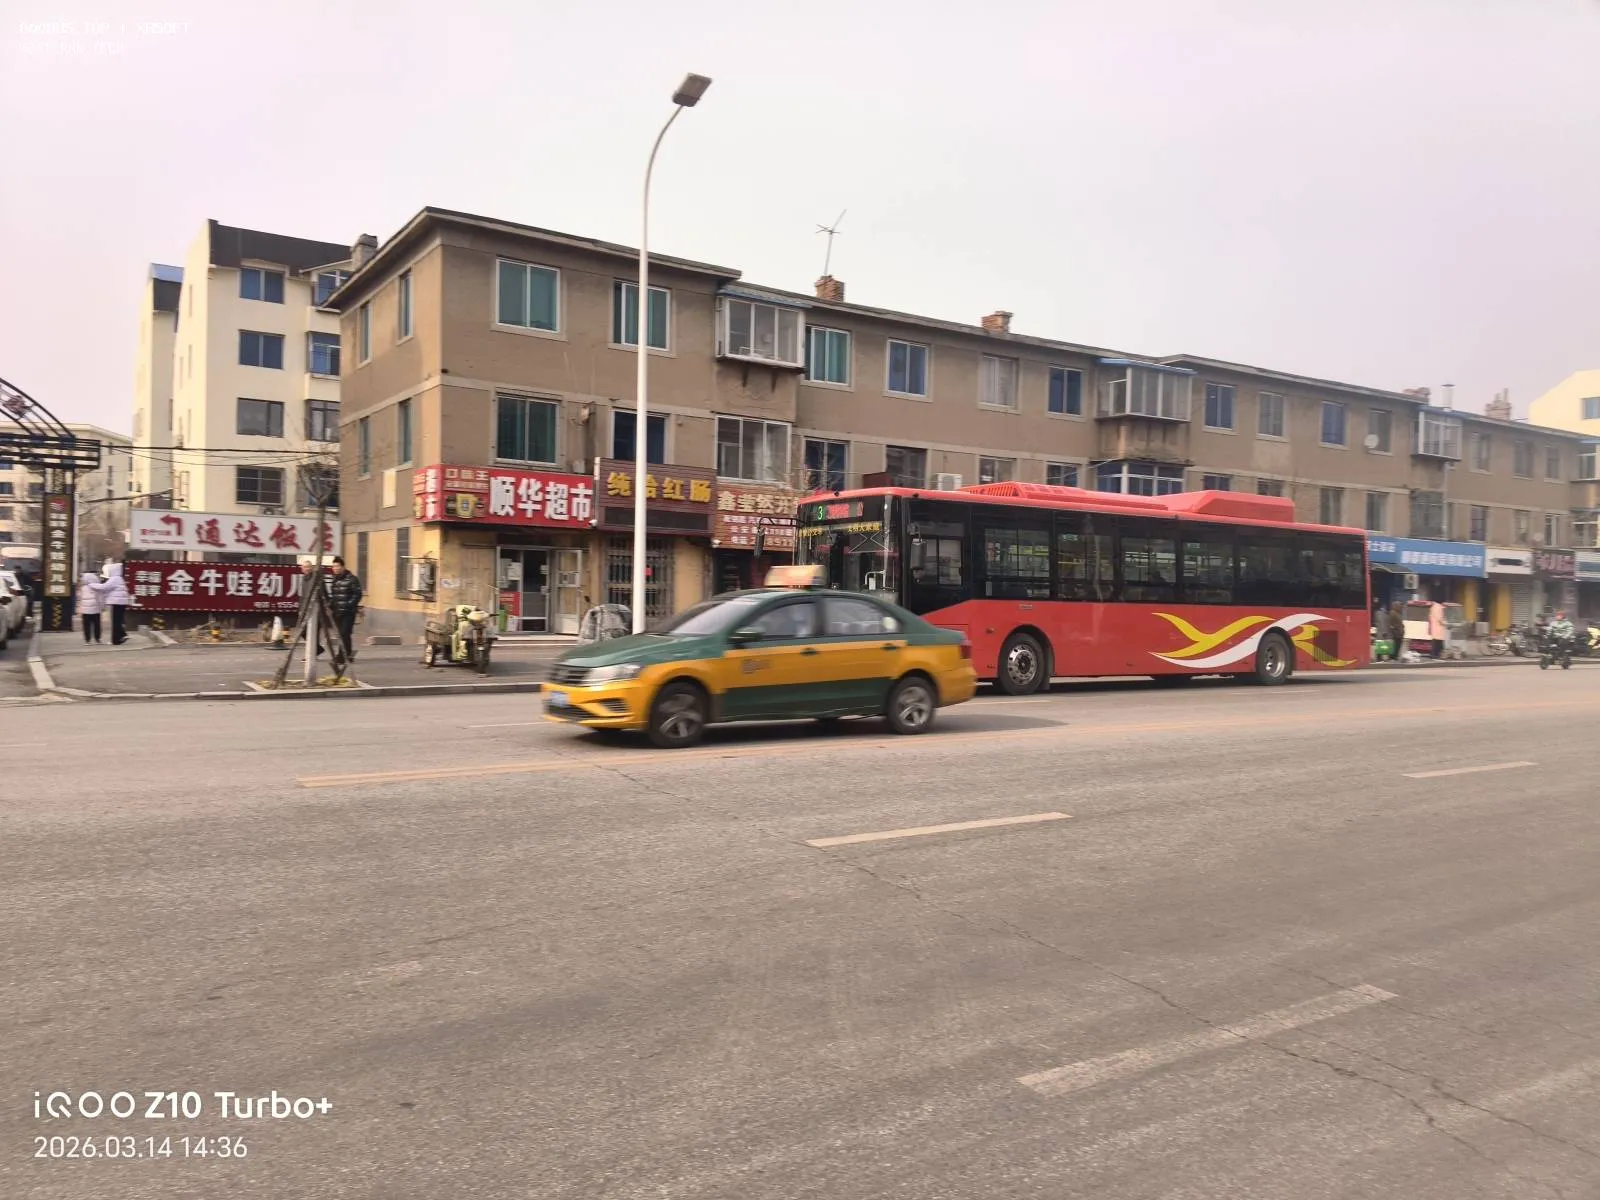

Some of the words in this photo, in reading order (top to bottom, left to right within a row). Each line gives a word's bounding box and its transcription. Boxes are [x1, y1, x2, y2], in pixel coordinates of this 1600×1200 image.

[488, 475, 593, 522] 顺华超市
[195, 518, 334, 553] 通达饭店
[167, 568, 333, 598] 金牛娃幼儿
